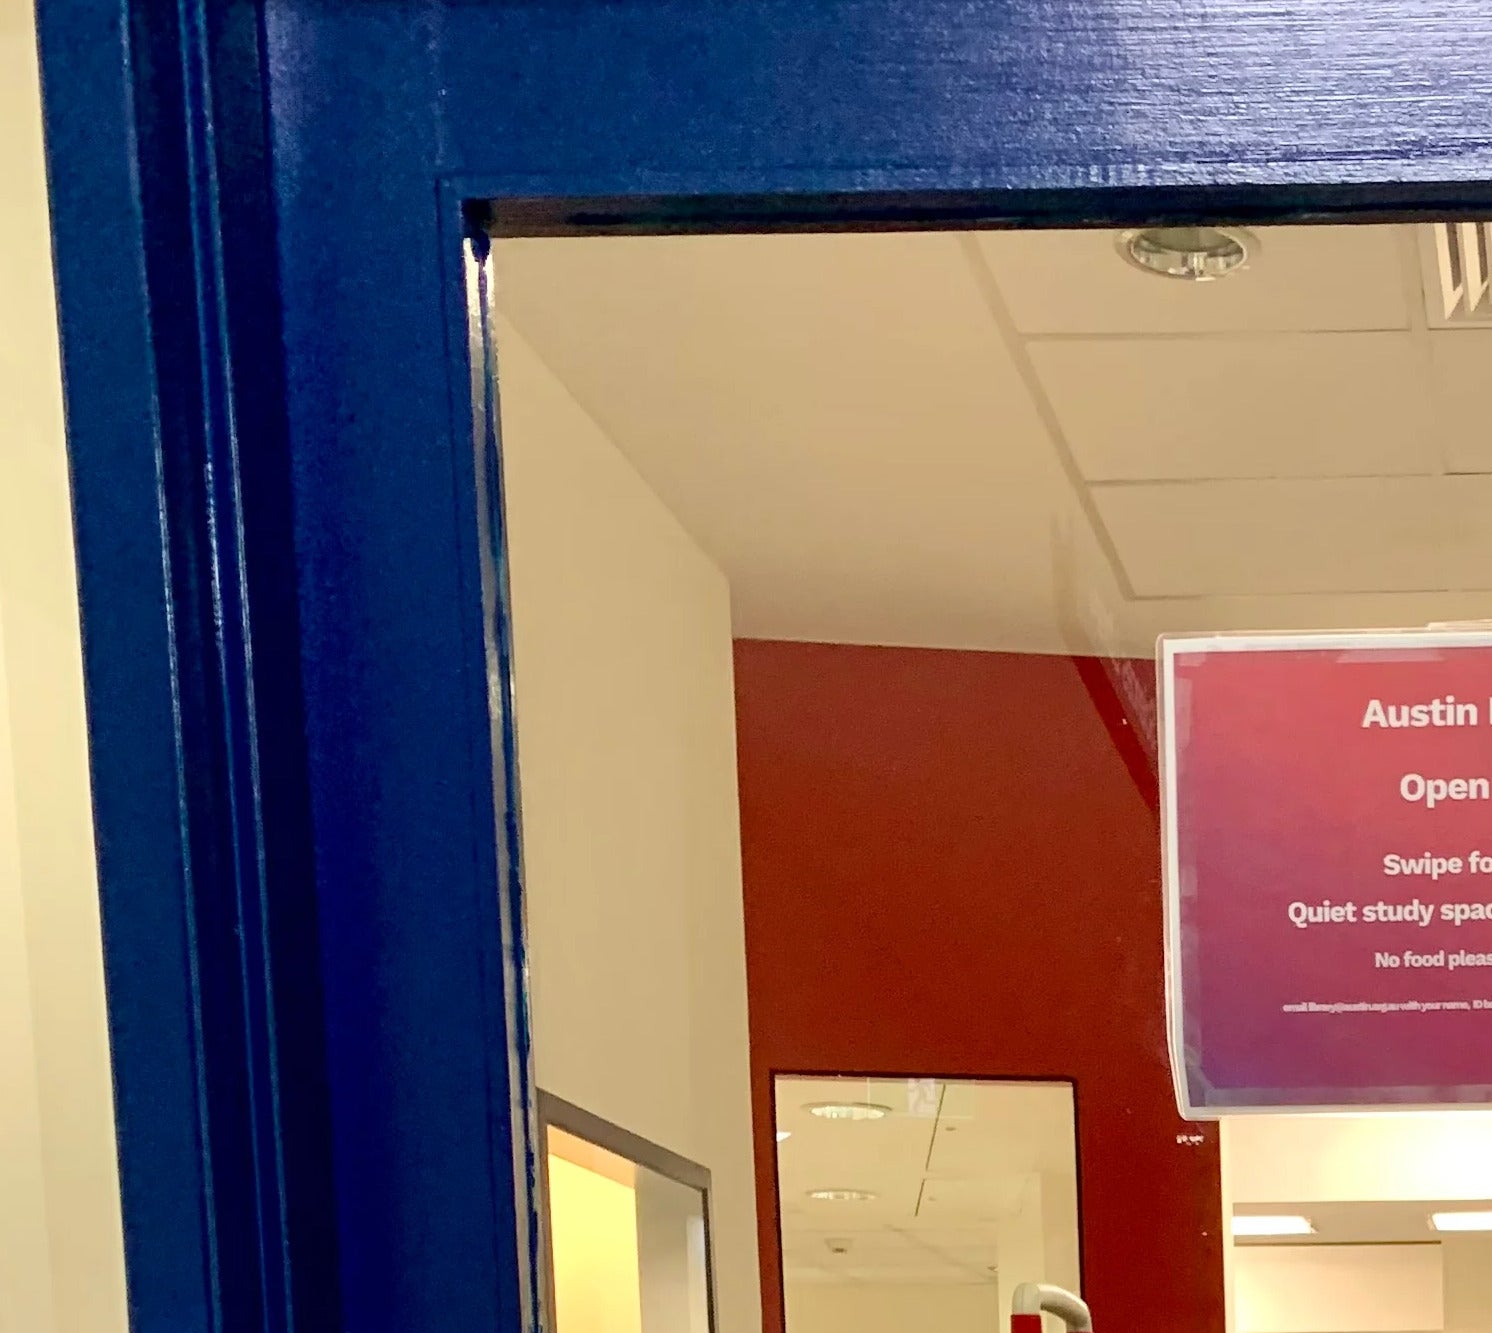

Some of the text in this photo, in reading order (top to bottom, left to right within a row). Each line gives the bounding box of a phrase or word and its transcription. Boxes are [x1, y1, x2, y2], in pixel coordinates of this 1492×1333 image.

[1361, 695, 1478, 728] Austin
[1400, 773, 1490, 809] Open
[1383, 851, 1463, 881] Swipe
[1287, 899, 1358, 929] Quiet
[1362, 898, 1435, 927] study
[1374, 951, 1401, 968] No
[1402, 949, 1445, 968] food
